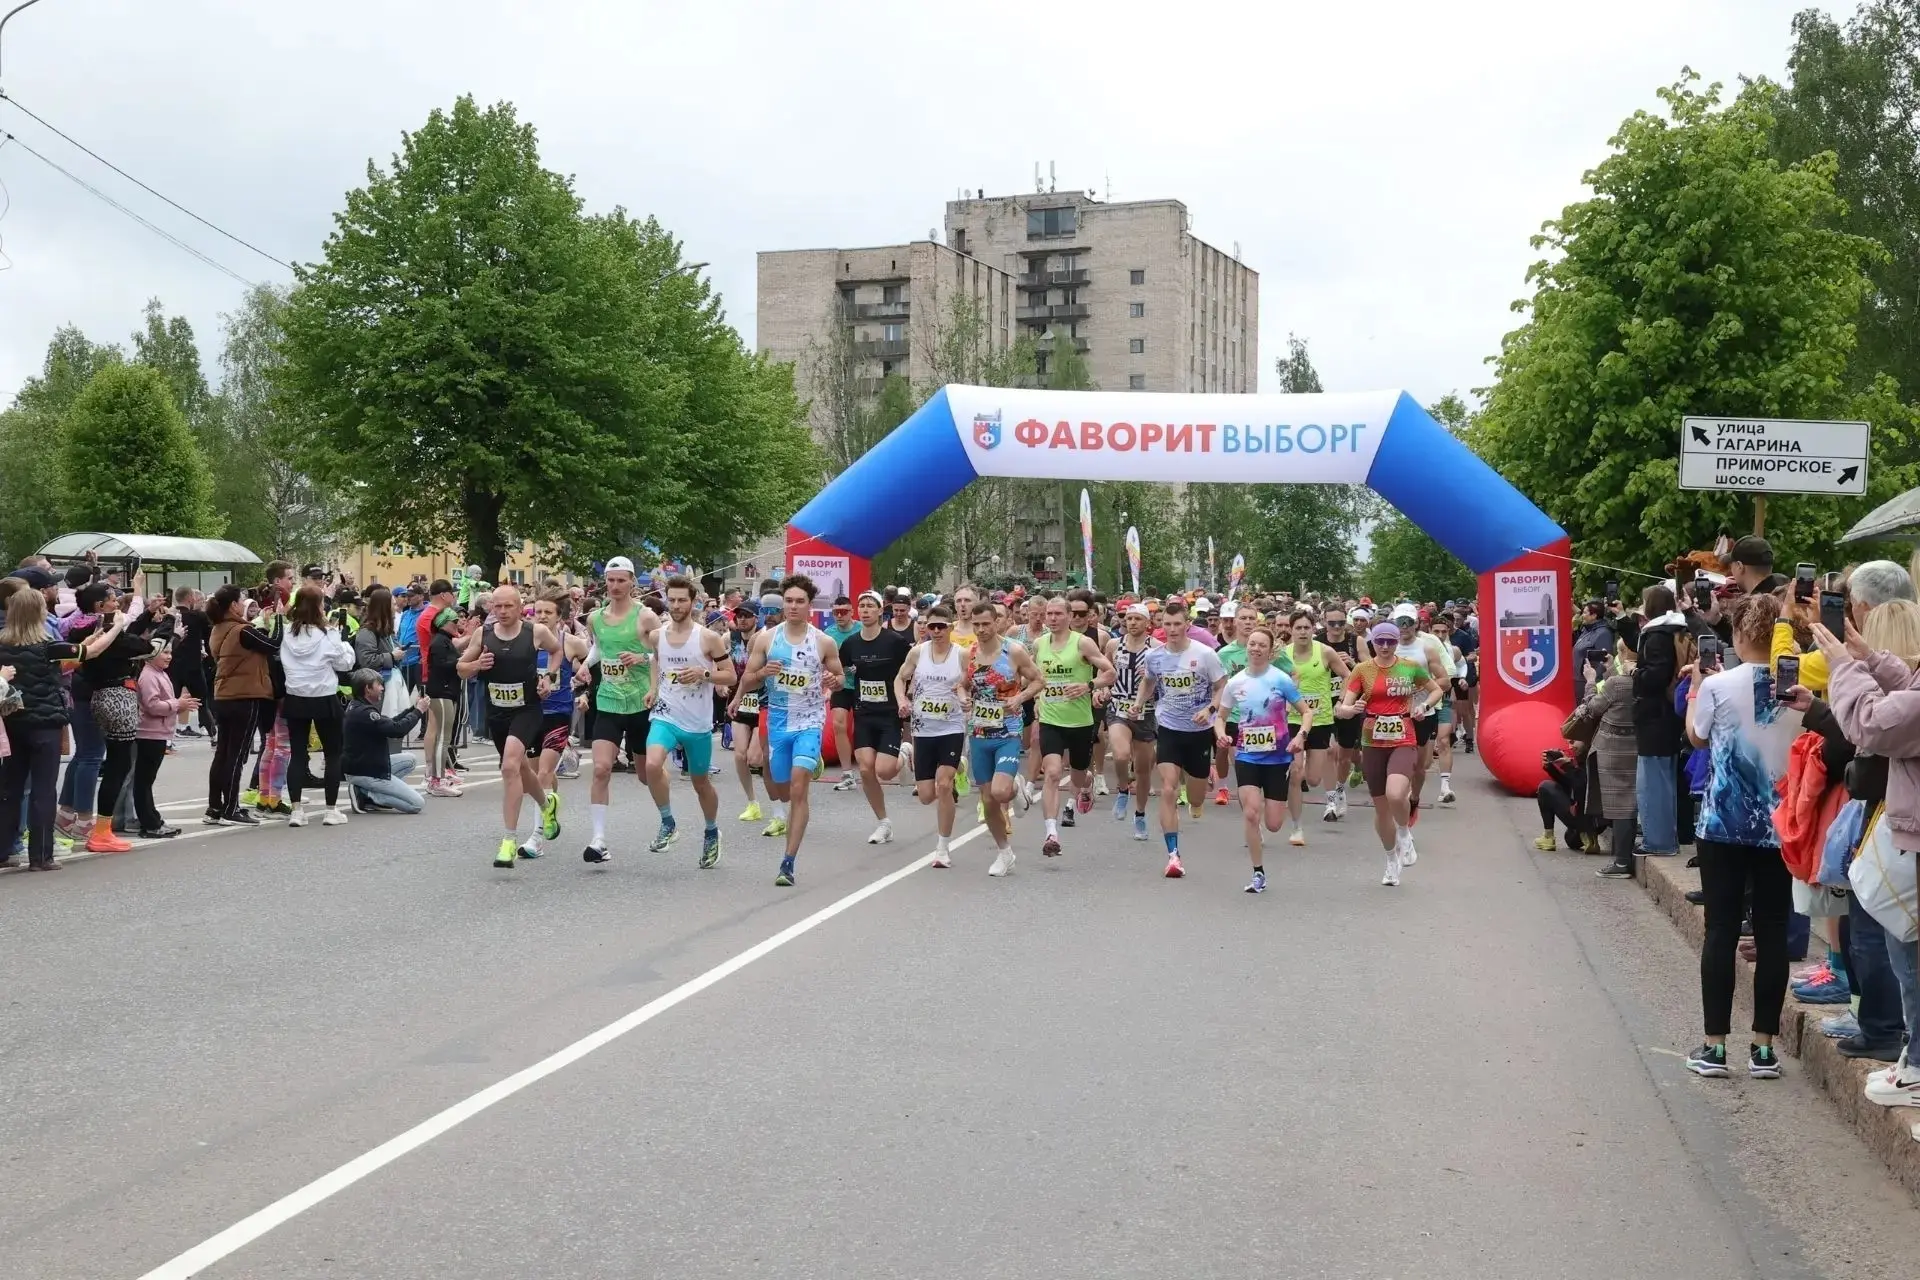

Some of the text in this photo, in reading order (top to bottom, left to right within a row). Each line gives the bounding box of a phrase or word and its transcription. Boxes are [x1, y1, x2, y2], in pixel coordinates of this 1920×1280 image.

[1716, 423, 1766, 435] улица
[1014, 418, 1367, 454] ФАВОРИТ ВЫБОРГ
[1716, 438, 1803, 453] ГАГАРИНА
[1716, 457, 1833, 474] ПРИМОРСКОЕ
[1715, 474, 1766, 486] шоссе
[797, 559, 843, 569] ФАВОРИТ
[807, 569, 832, 577] ВЫБОРГ
[1501, 575, 1551, 584] ФАВОРИТ
[1513, 585, 1541, 593] ВЫБОРГ
[602, 664, 625, 676] 2259
[777, 673, 806, 687] 2128
[1164, 676, 1191, 688] 2330
[494, 688, 518, 700] 2113
[861, 685, 885, 696] 2035
[1044, 686, 1066, 697] 233
[921, 701, 948, 713] 2364
[975, 706, 1001, 719] 2296
[1375, 722, 1403, 733] 2325
[1245, 732, 1274, 745] 2304
